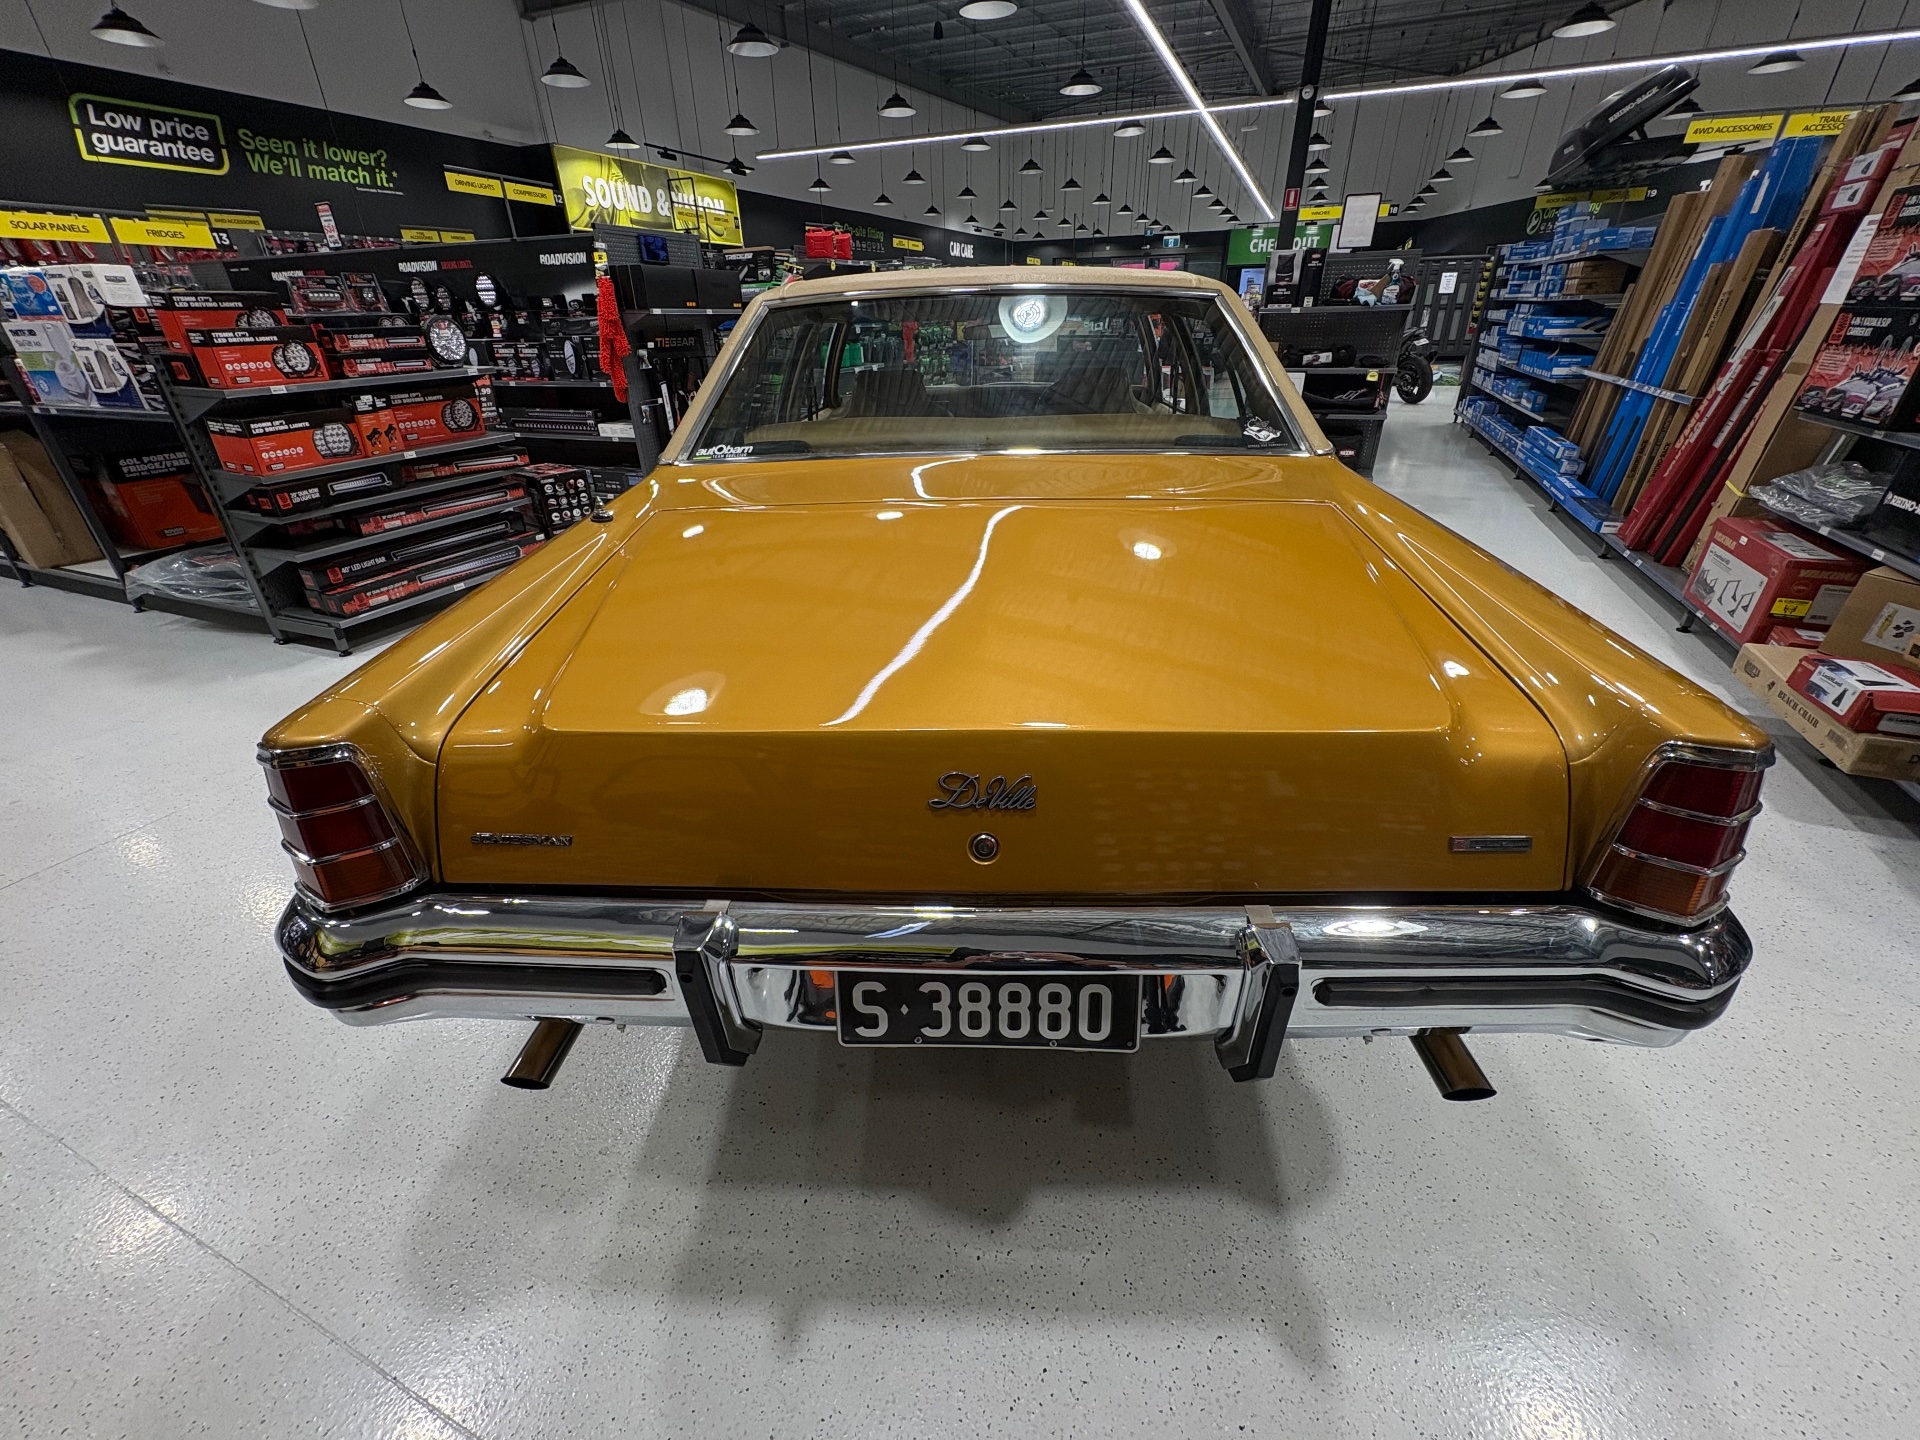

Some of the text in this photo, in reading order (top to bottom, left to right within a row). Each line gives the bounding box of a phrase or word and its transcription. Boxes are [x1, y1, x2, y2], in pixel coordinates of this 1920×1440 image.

[87, 103, 210, 141] Low price
[1820, 114, 1849, 125] TRAILE
[1691, 122, 1774, 136] 4WD ACCESSORIES
[1801, 122, 1846, 133] ACCESSO
[91, 132, 215, 163] guarantee
[237, 128, 387, 167] Seen it lower?
[245, 151, 302, 178] We'll
[307, 164, 371, 185] match
[454, 178, 495, 191] DRIVING LIGHTS
[512, 188, 548, 199] COMPRESSORS
[582, 175, 652, 214] SOUND
[656, 188, 671, 217] &
[1647, 189, 1657, 198] 19
[1389, 206, 1399, 214] 18
[9, 220, 90, 234] SOLAR PANELS
[145, 229, 185, 239] FRIDGES
[212, 232, 230, 245] 13
[1250, 235, 1320, 253] CHEOUT
[950, 241, 974, 259] CAR CARE
[540, 252, 587, 265] ROADVISION
[398, 260, 438, 273] ROADVISION
[655, 337, 695, 348] TIEGEAR
[265, 425, 289, 433] DRIVING
[289, 422, 310, 430] LIGHTS
[118, 457, 141, 466] 60L
[1890, 494, 1920, 515] RHINO-
[351, 563, 362, 571] LED
[362, 559, 375, 569] LIGHT
[375, 556, 387, 566] BAR
[1777, 689, 1820, 729] BEACH CHAIR
[470, 832, 574, 847] STATESMAN
[852, 981, 1112, 1041] S 38880
